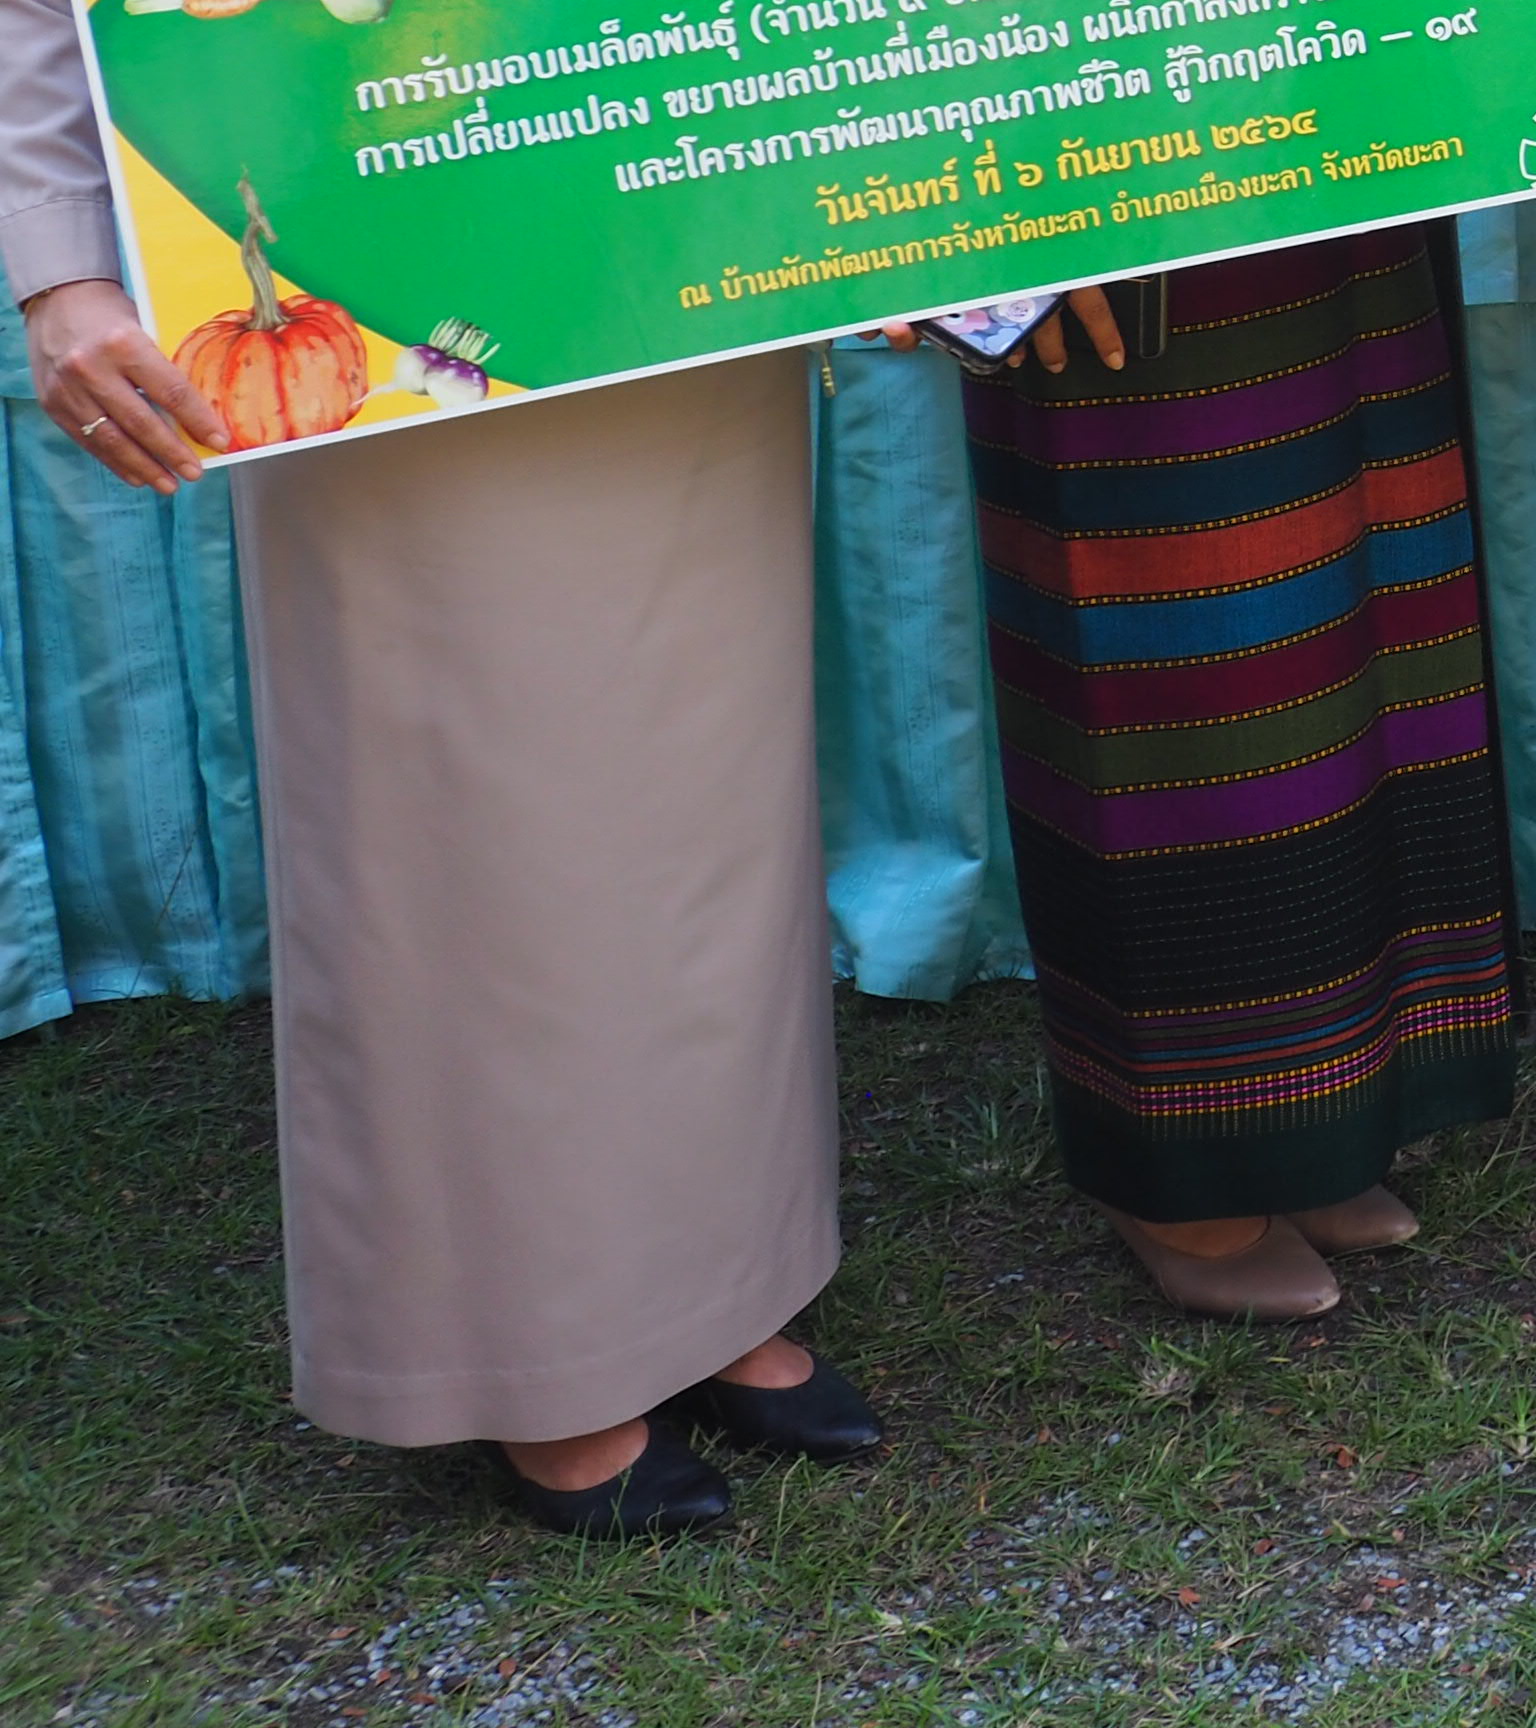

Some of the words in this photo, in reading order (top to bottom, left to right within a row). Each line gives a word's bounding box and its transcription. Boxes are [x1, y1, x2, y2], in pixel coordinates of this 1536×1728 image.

[355, 0, 738, 111] การรับมอบเมล็ดพันธุ์
[355, 94, 651, 177] การเปลี่ยนแปลง
[664, 14, 1068, 120] ขยายผลบ้านพี่เมืองน้อง
[614, 56, 1151, 193] และโครงการพัฒนาคุณภาพชีวิต
[1165, 21, 1367, 102] สู้วิกฤตโควิด
[1425, 6, 1478, 43] ๑๙
[679, 284, 711, 311] ณ
[721, 204, 1101, 301] บ้านพักพัฒนาการจังหวัดยะลา
[1111, 165, 1312, 225] อำเภอเมืองยะลา
[1322, 133, 1463, 184] จังหวัดยะลา
[815, 157, 960, 227] วันจันทร์
[973, 138, 1002, 196] ที่
[1015, 162, 1043, 189] ๖
[1056, 127, 1200, 185] กันยายน
[1211, 107, 1318, 151] ๒๕๖๔
